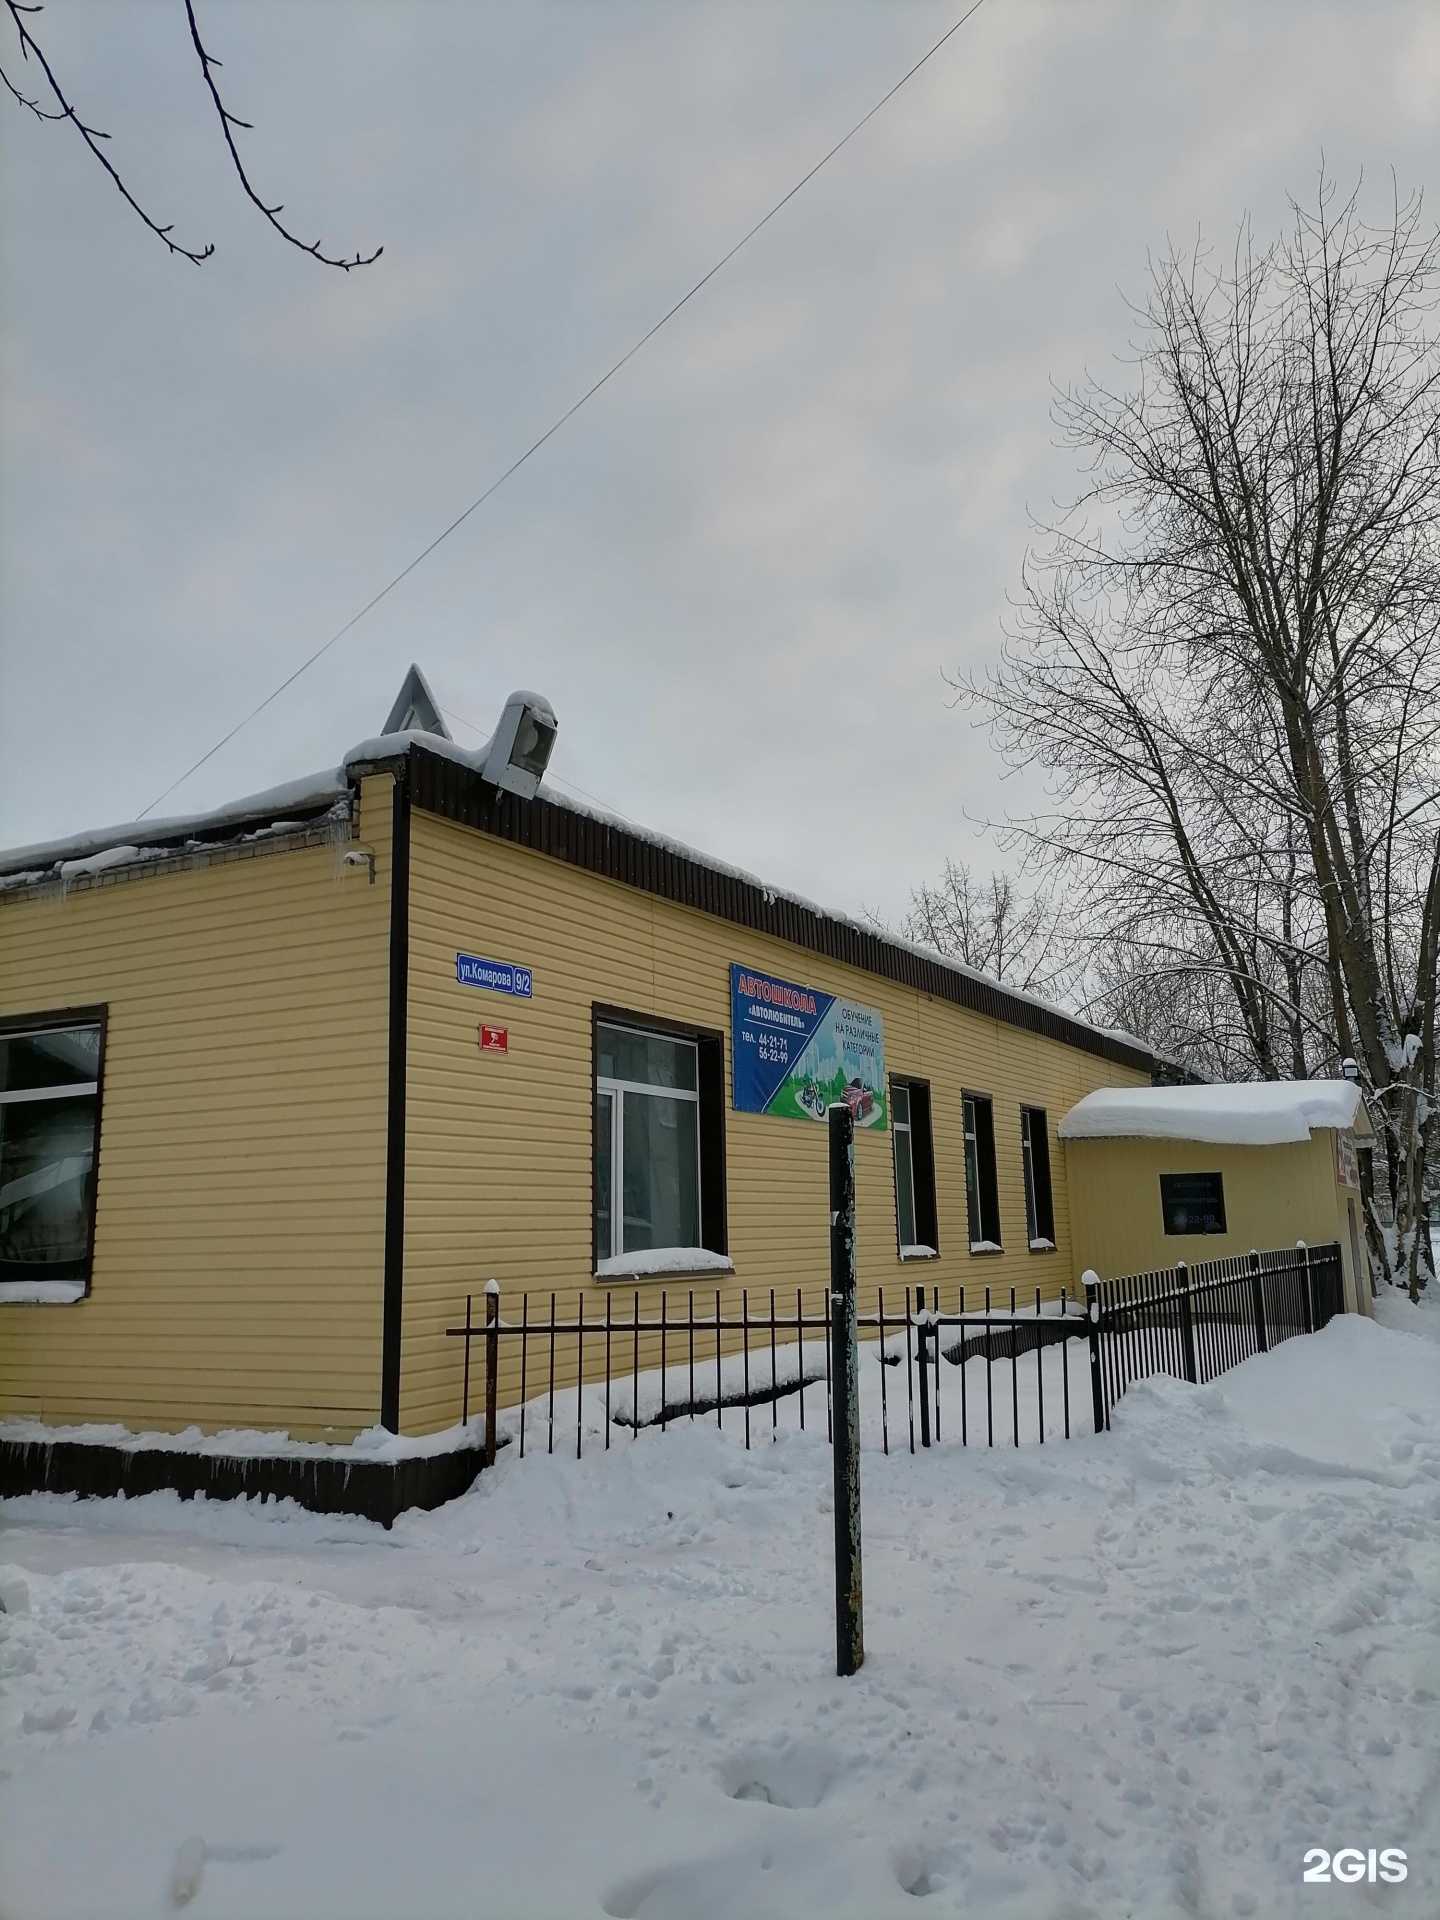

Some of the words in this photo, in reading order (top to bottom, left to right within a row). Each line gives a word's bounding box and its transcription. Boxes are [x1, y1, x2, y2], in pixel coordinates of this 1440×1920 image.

[461, 963, 511, 987] ул.Комарова
[516, 973, 530, 992] 9/2
[738, 974, 817, 1015] АВТОШКОЛА
[841, 1008, 873, 1026] ОБУЧЕНИЕ
[742, 1031, 757, 1043] тел.
[759, 1032, 788, 1051] 44-21-71
[835, 1024, 845, 1034] НА
[845, 1025, 880, 1043] РАЗЛИЧНЫЕ
[759, 1046, 788, 1064] 56-22-99
[842, 1040, 875, 1058] КАТЕГОРИИ
